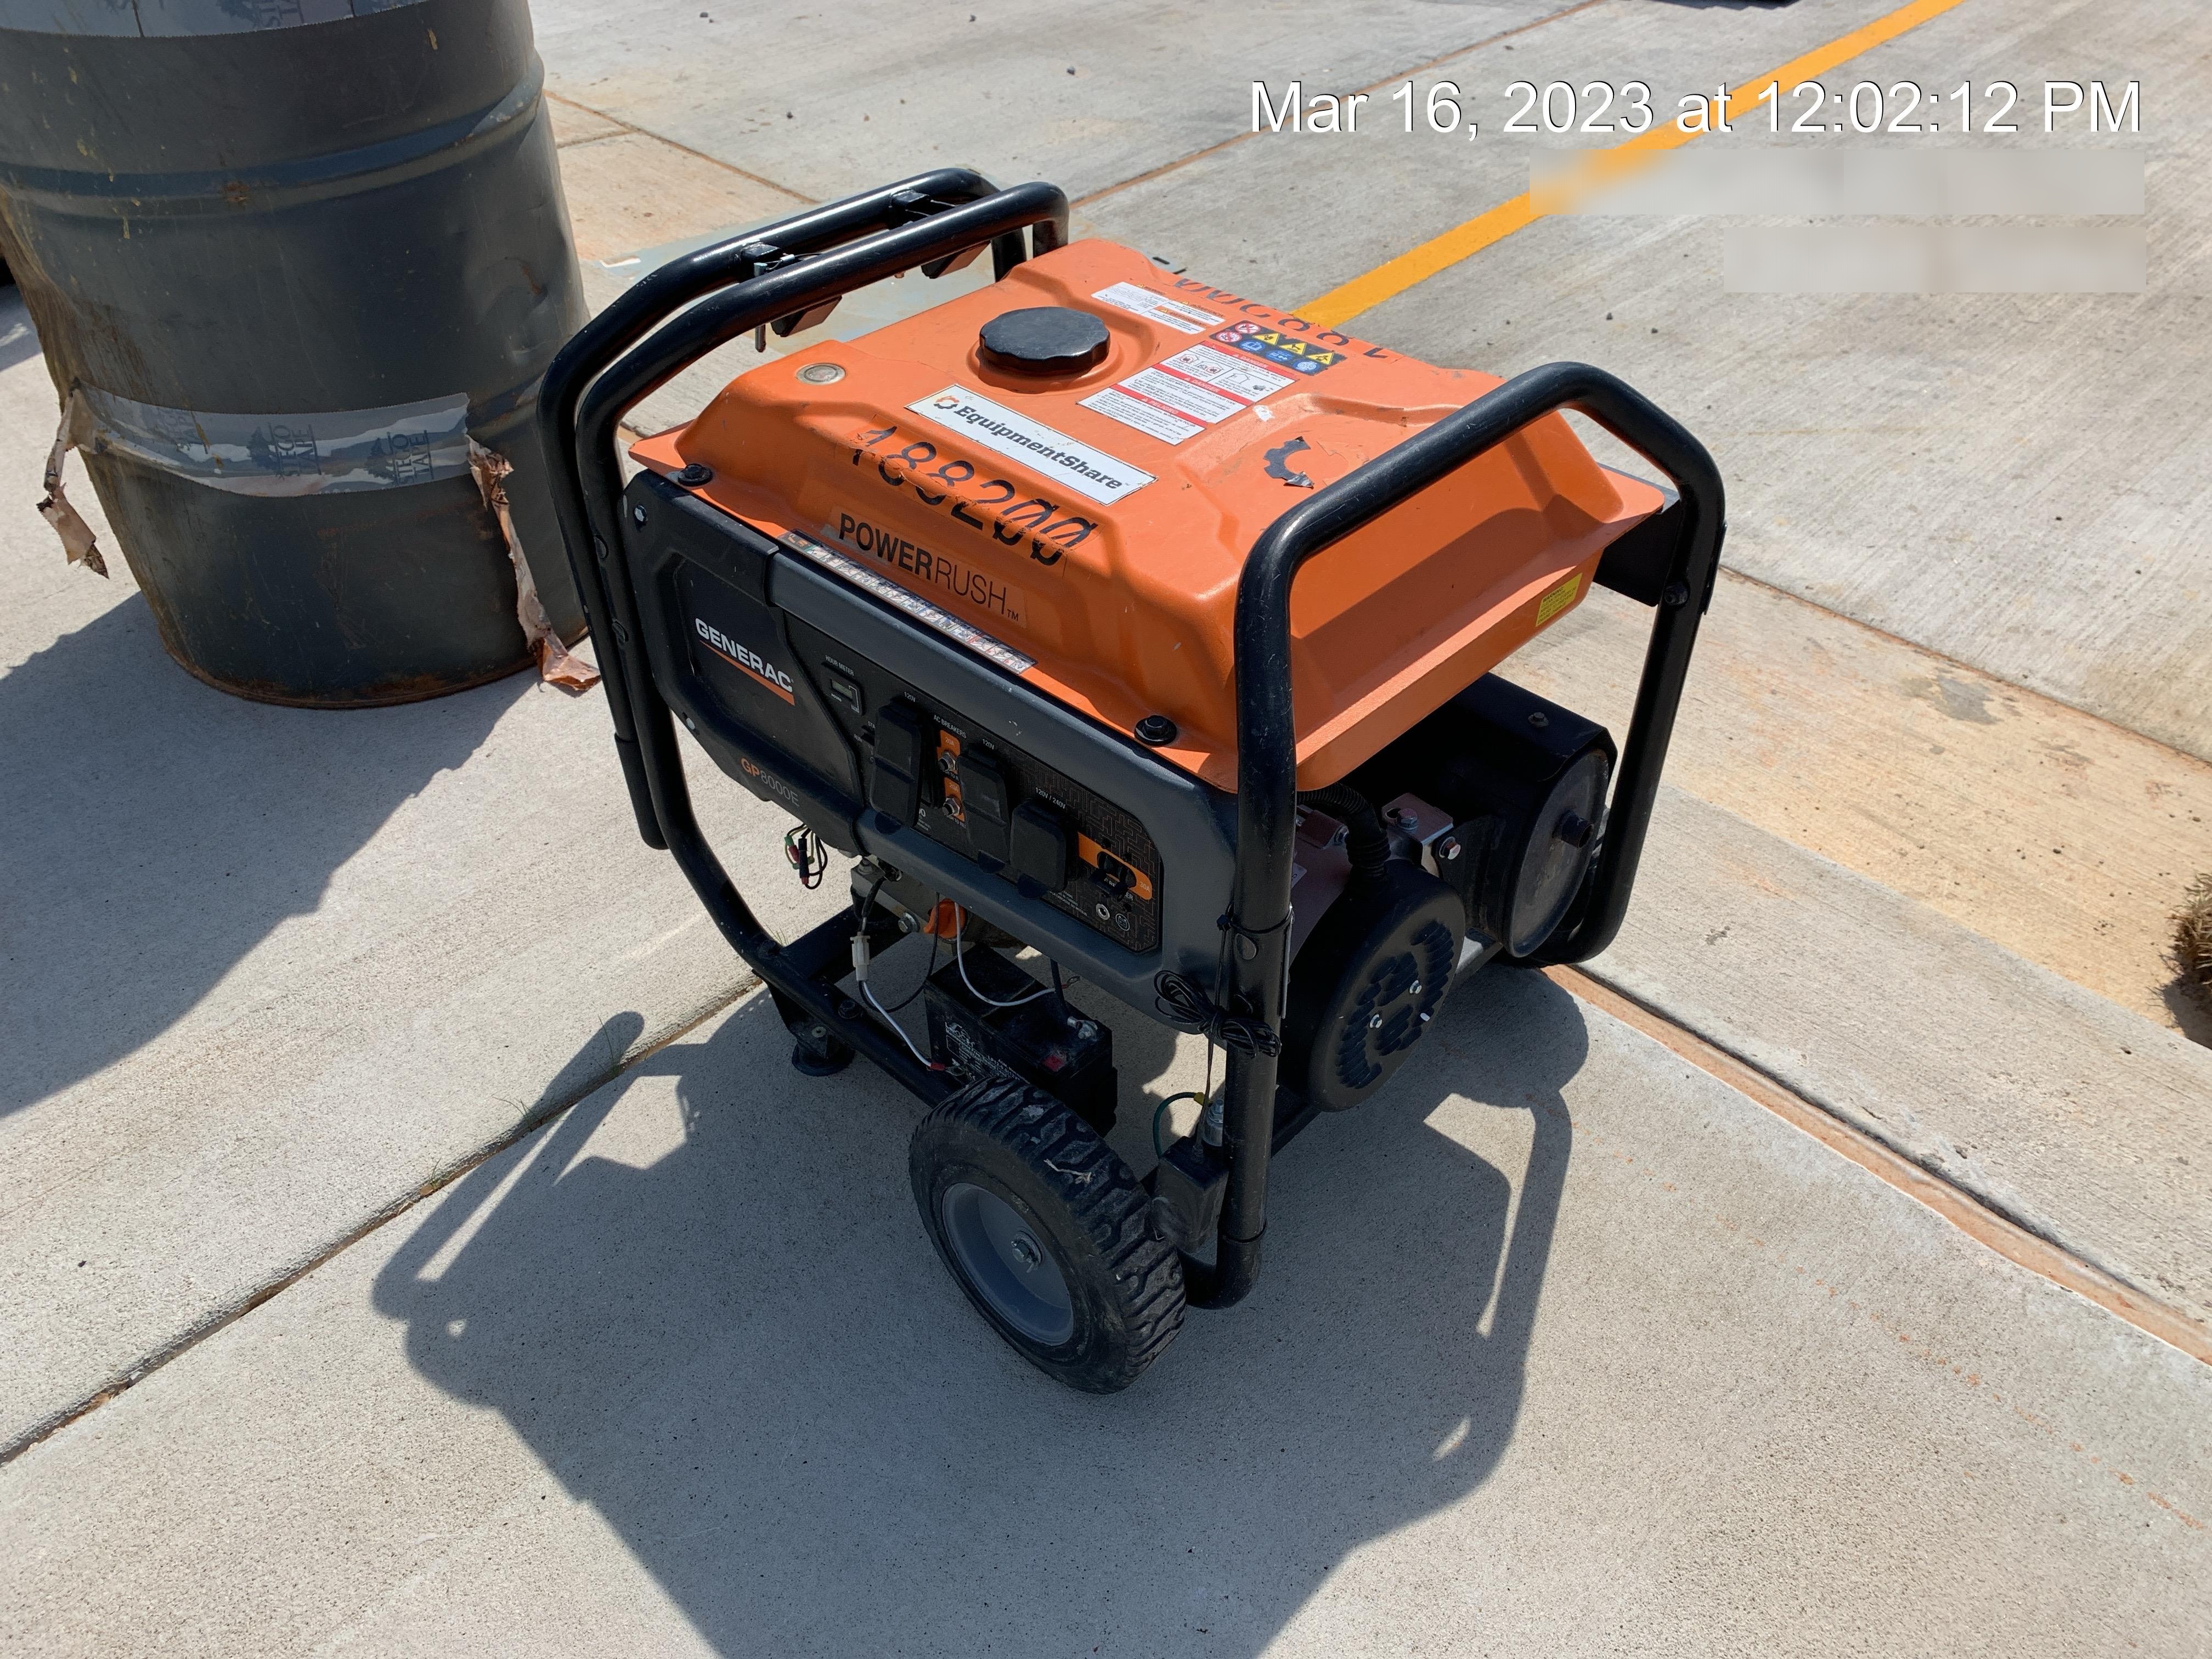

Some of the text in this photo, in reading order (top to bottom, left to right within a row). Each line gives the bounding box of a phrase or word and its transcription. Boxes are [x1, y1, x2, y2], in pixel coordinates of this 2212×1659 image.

[1192, 379, 1221, 393] DANGER
[1149, 398, 1179, 414] PELIGRO
[409, 436, 431, 478] TAPE
[953, 405, 1123, 489] EquipmentShare
[392, 433, 416, 484] STEGO
[695, 618, 793, 693] GENERAC
[825, 654, 854, 676] HOUR METER
[904, 691, 916, 703] 120V
[933, 714, 967, 739] AC BREAKERS
[945, 737, 955, 746] 20A
[982, 738, 995, 750] 120V
[741, 758, 800, 807] GP8000E
[1035, 787, 1048, 799] 120V
[1052, 798, 1066, 810] 240V
[1139, 881, 1150, 893] 30A
